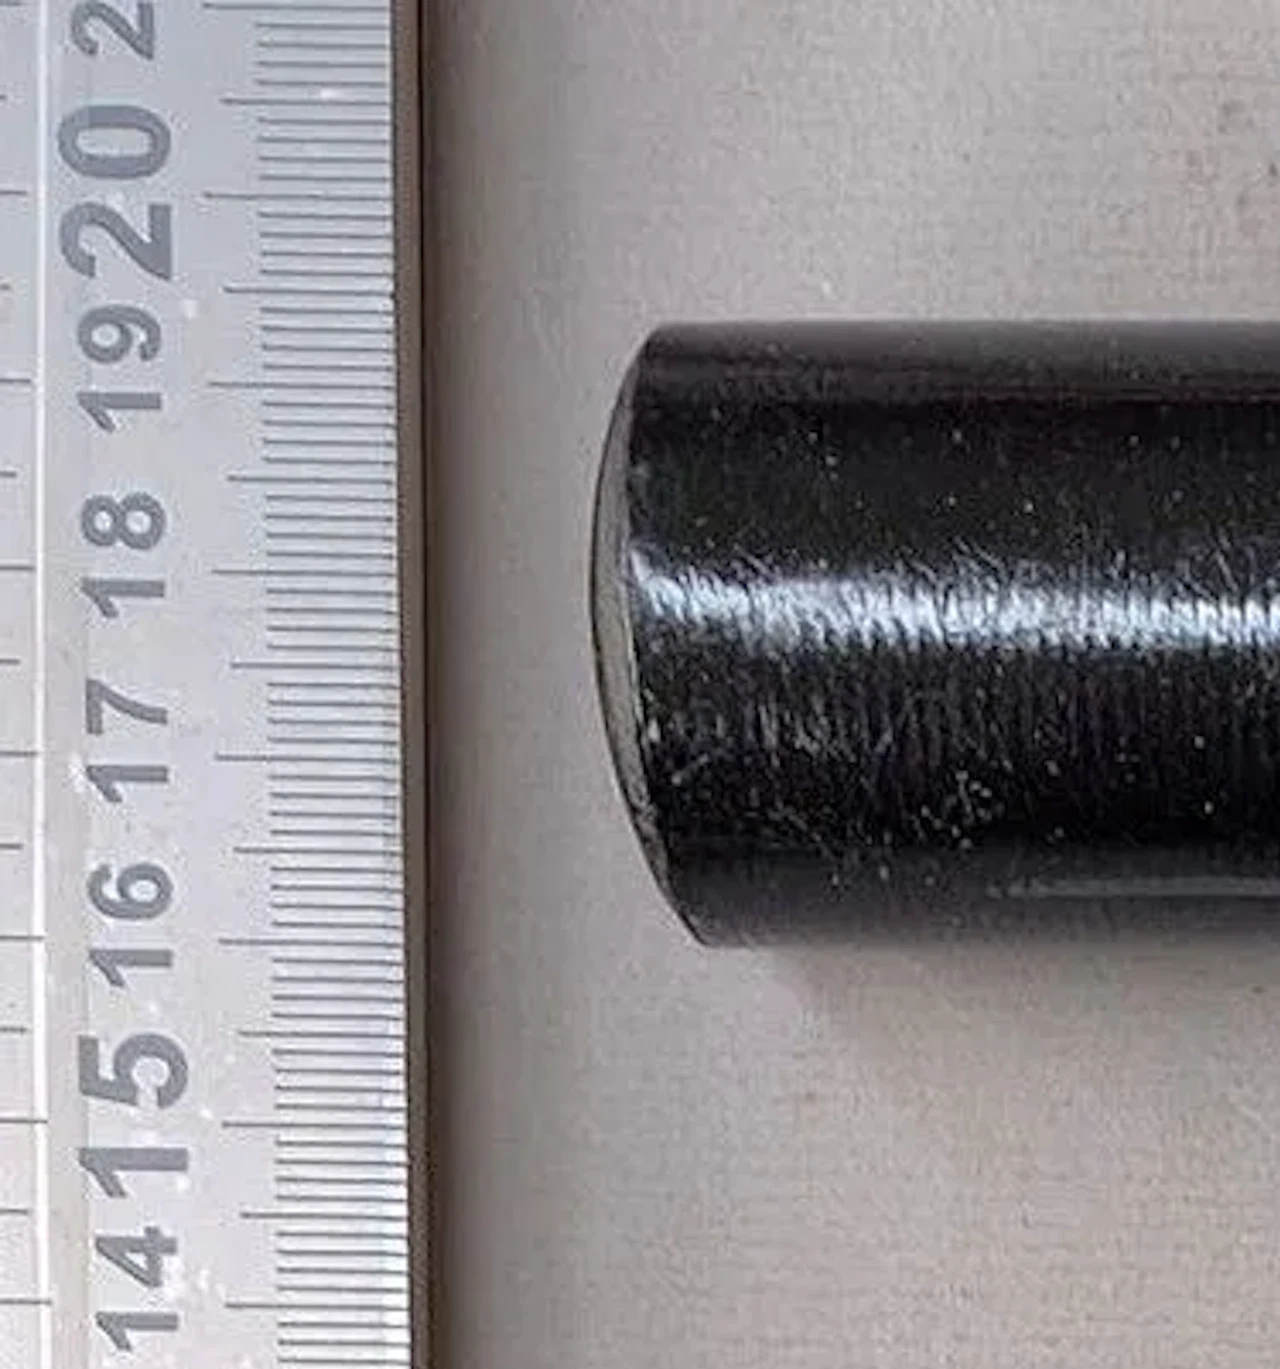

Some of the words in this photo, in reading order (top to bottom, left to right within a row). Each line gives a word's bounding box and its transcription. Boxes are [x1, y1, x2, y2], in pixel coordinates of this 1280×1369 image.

[58, 106, 171, 281] 20
[77, 306, 161, 432] 19
[80, 493, 165, 618] 18
[85, 678, 168, 803] 17
[87, 864, 173, 987] 16
[77, 1034, 188, 1198] 15
[95, 1227, 178, 1351] 14
